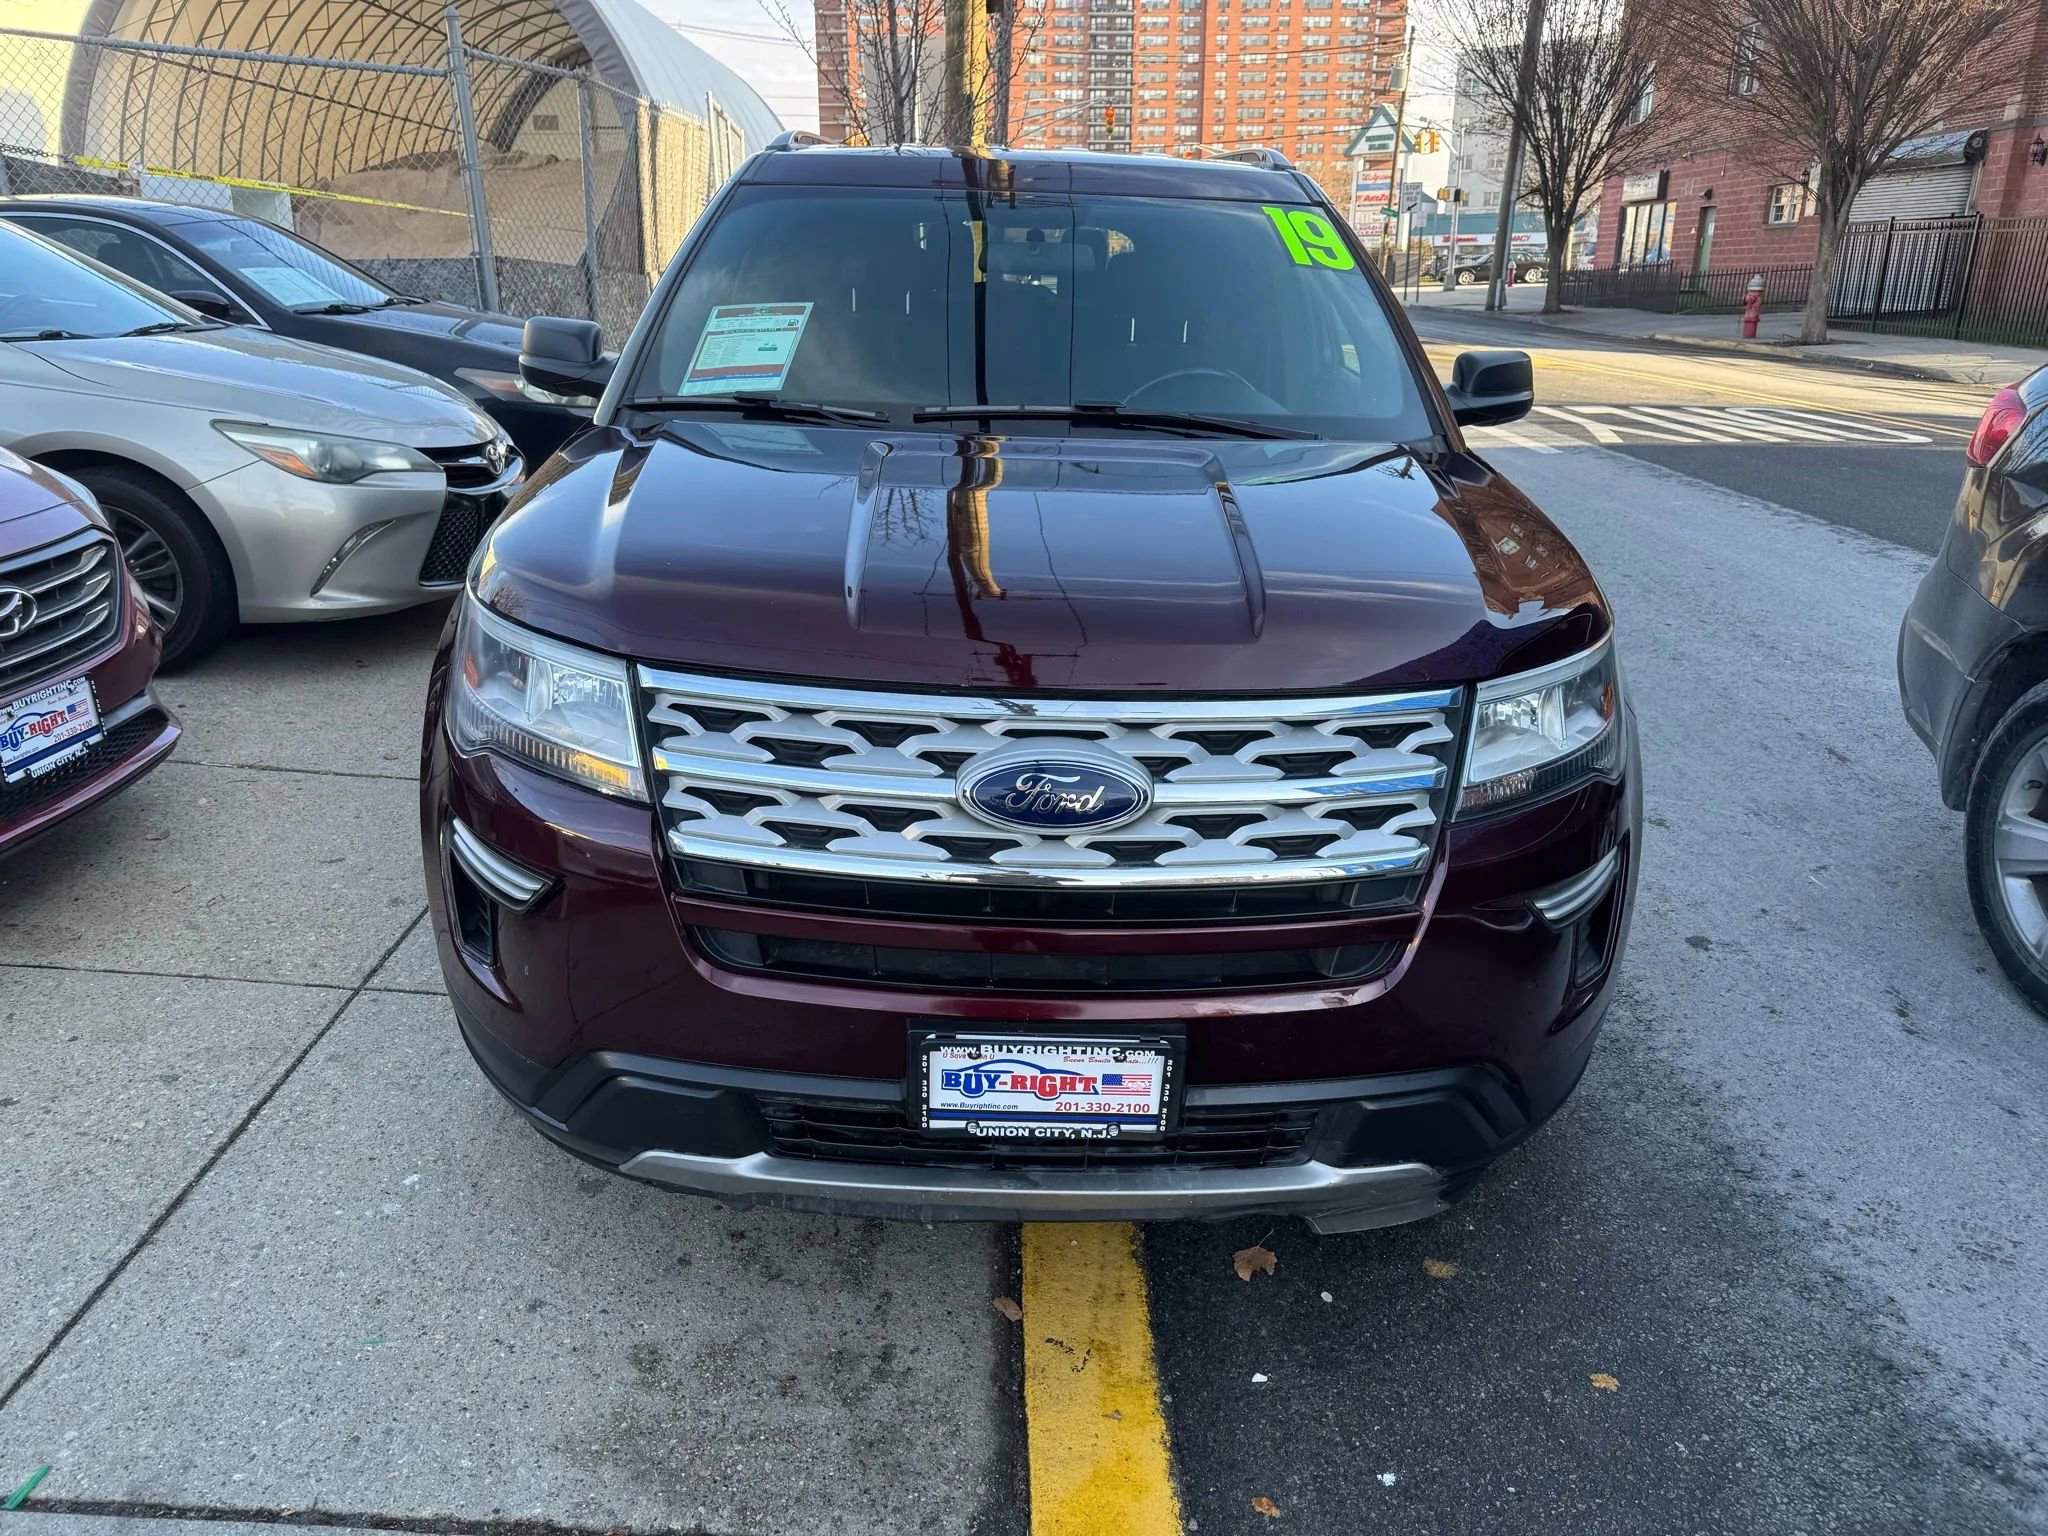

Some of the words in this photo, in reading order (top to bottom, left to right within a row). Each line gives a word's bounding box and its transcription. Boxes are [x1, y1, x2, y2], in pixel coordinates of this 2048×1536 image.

[1261, 206, 1355, 270] 19
[0, 711, 66, 748] BUY-RIGHT
[53, 719, 93, 742] 201-330-2100
[31, 760, 56, 778] UNION
[1006, 772, 1105, 814] Ford
[943, 1071, 1098, 1098] BUY-RIGHT
[1163, 1083, 1171, 1102] 330
[940, 1101, 1018, 1110] www.Buyrightinc.com
[1055, 1101, 1150, 1113] 201-330-2100
[1159, 1107, 1168, 1132] 2100
[976, 1127, 1030, 1137] UNION
[1034, 1128, 1076, 1139] CITY,
[1080, 1129, 1112, 1139] N.J.
